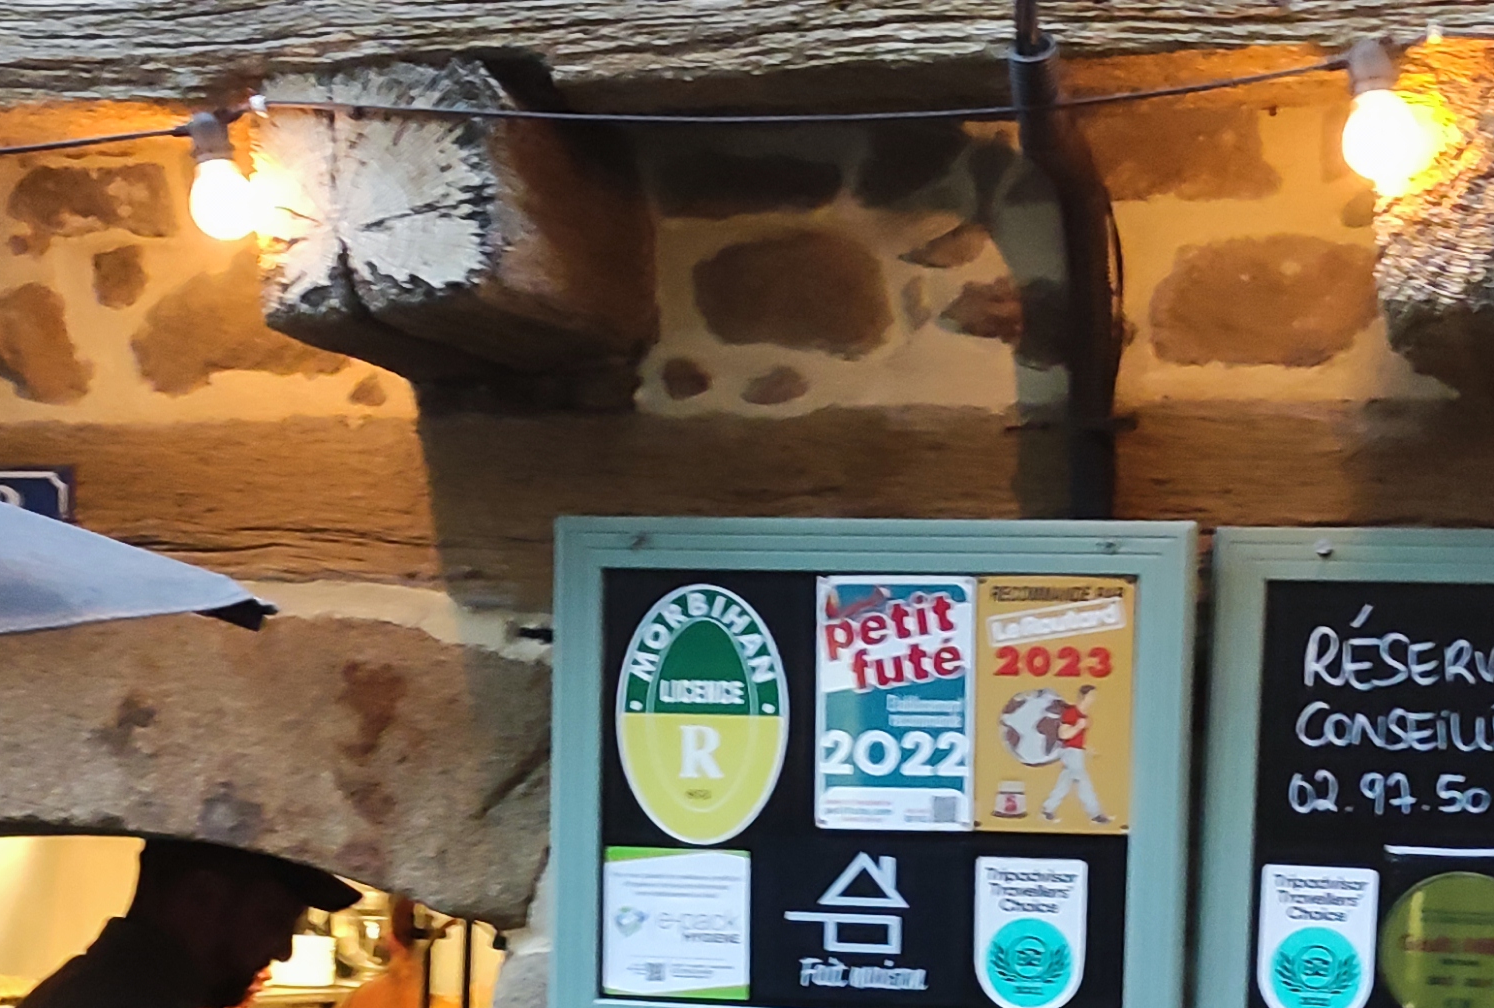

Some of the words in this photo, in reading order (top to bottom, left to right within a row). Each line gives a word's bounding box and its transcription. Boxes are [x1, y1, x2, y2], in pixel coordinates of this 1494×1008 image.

[629, 592, 776, 682] MORBIHAN
[825, 594, 955, 661] petit
[853, 637, 965, 690] futé
[993, 646, 1113, 679] 2023
[659, 679, 746, 705] LICENCE
[678, 724, 726, 780] R
[819, 729, 970, 777] 2022
[985, 867, 1079, 886] Tripadvisor
[1273, 873, 1369, 892] Tripadvisor
[998, 898, 1060, 914] Choice
[1285, 905, 1348, 923] Choice
